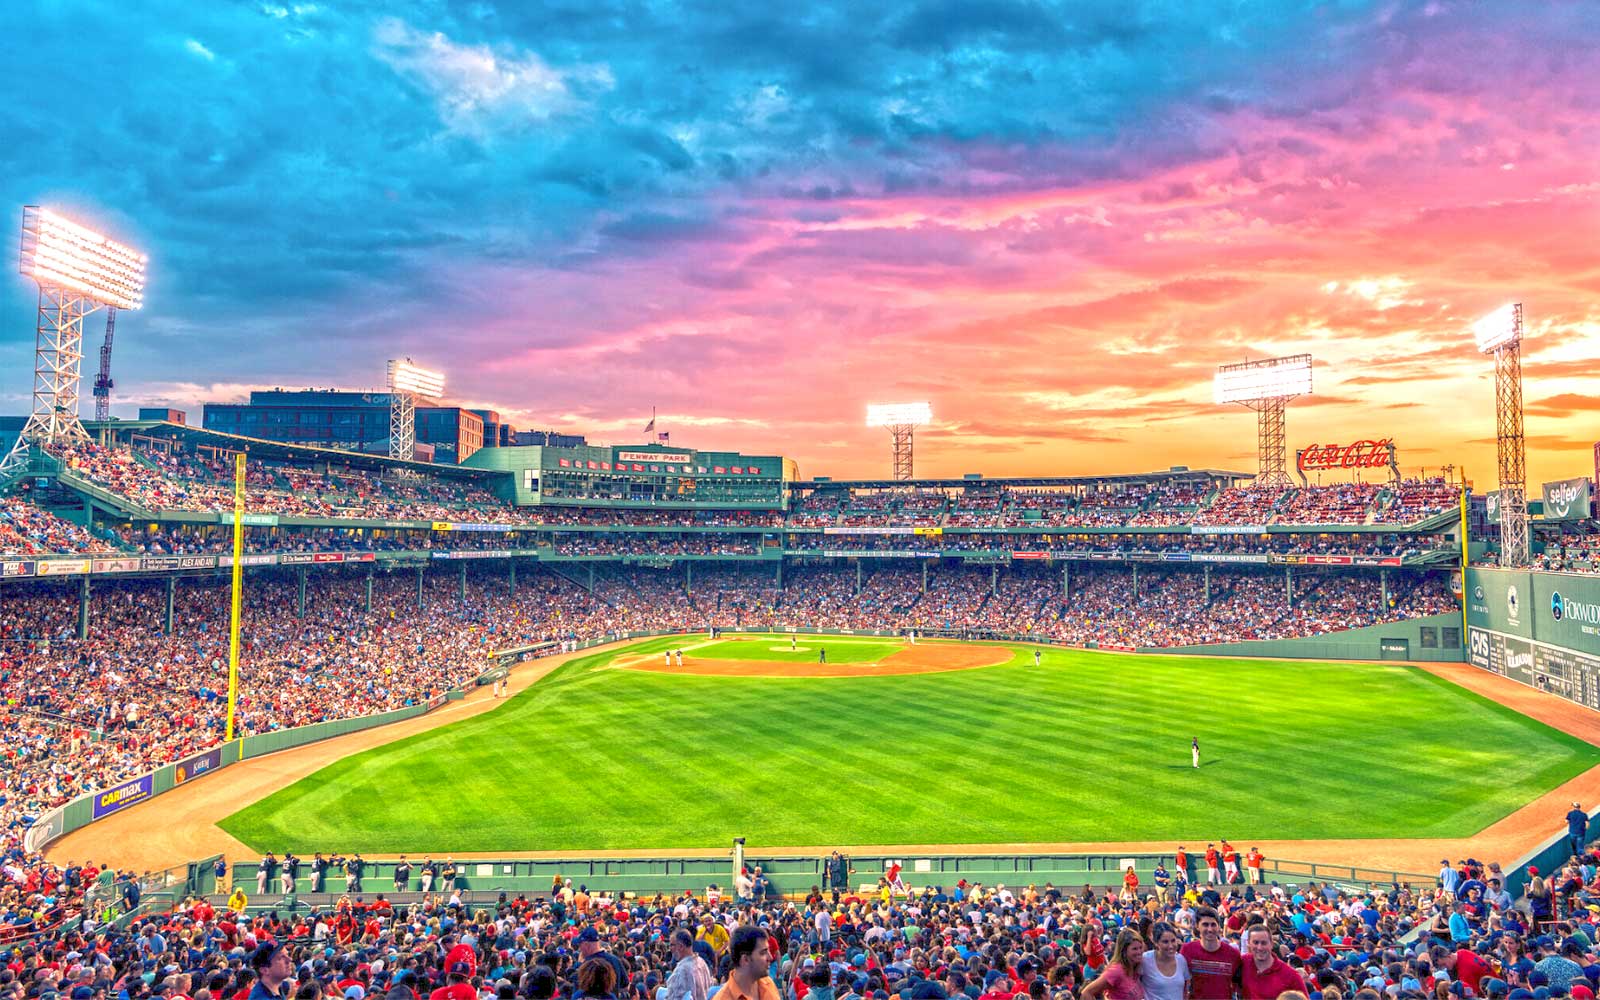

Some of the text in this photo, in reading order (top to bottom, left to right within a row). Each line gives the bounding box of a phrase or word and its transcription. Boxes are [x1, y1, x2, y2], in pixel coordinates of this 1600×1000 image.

[623, 453, 658, 461] FENWAY
[1299, 438, 1392, 471] Coca-Cola
[1471, 630, 1489, 657] CVS
